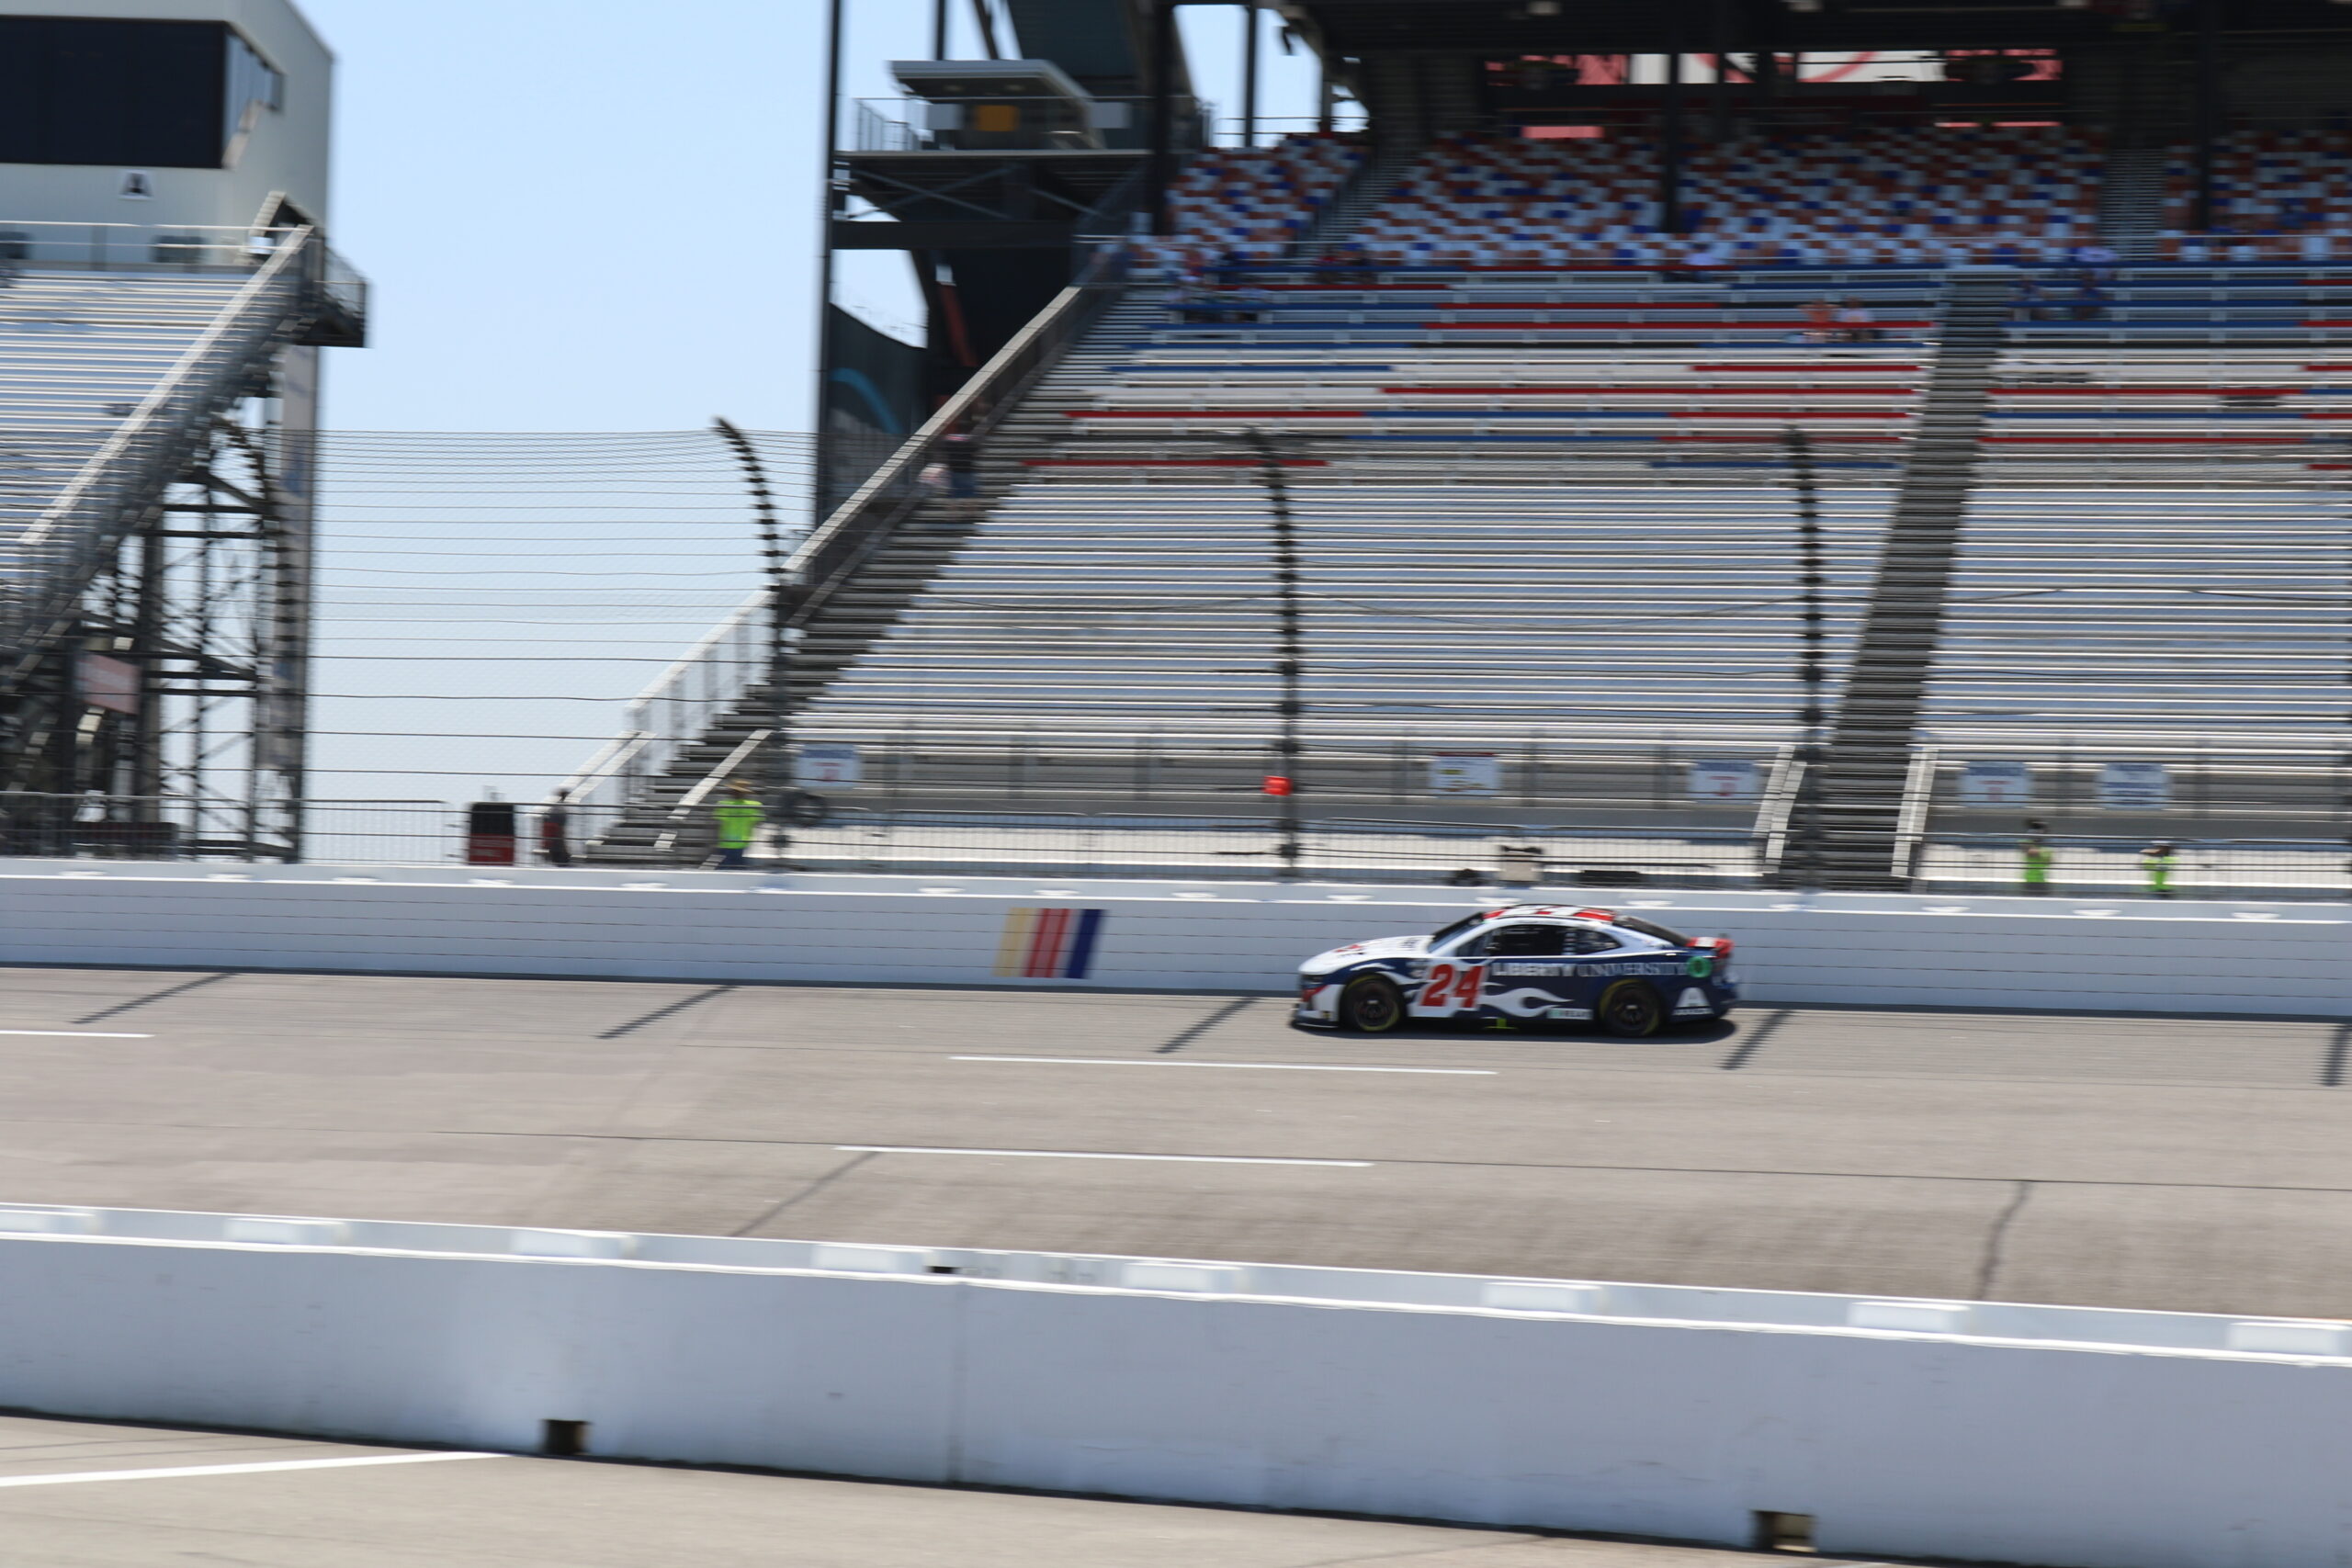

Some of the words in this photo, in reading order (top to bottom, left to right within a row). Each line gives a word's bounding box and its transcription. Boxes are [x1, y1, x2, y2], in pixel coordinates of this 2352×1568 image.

[1491, 963, 1577, 977] LIBERTY
[1577, 962, 1690, 977] UNIVERSITY
[1418, 964, 1487, 1009] 24
